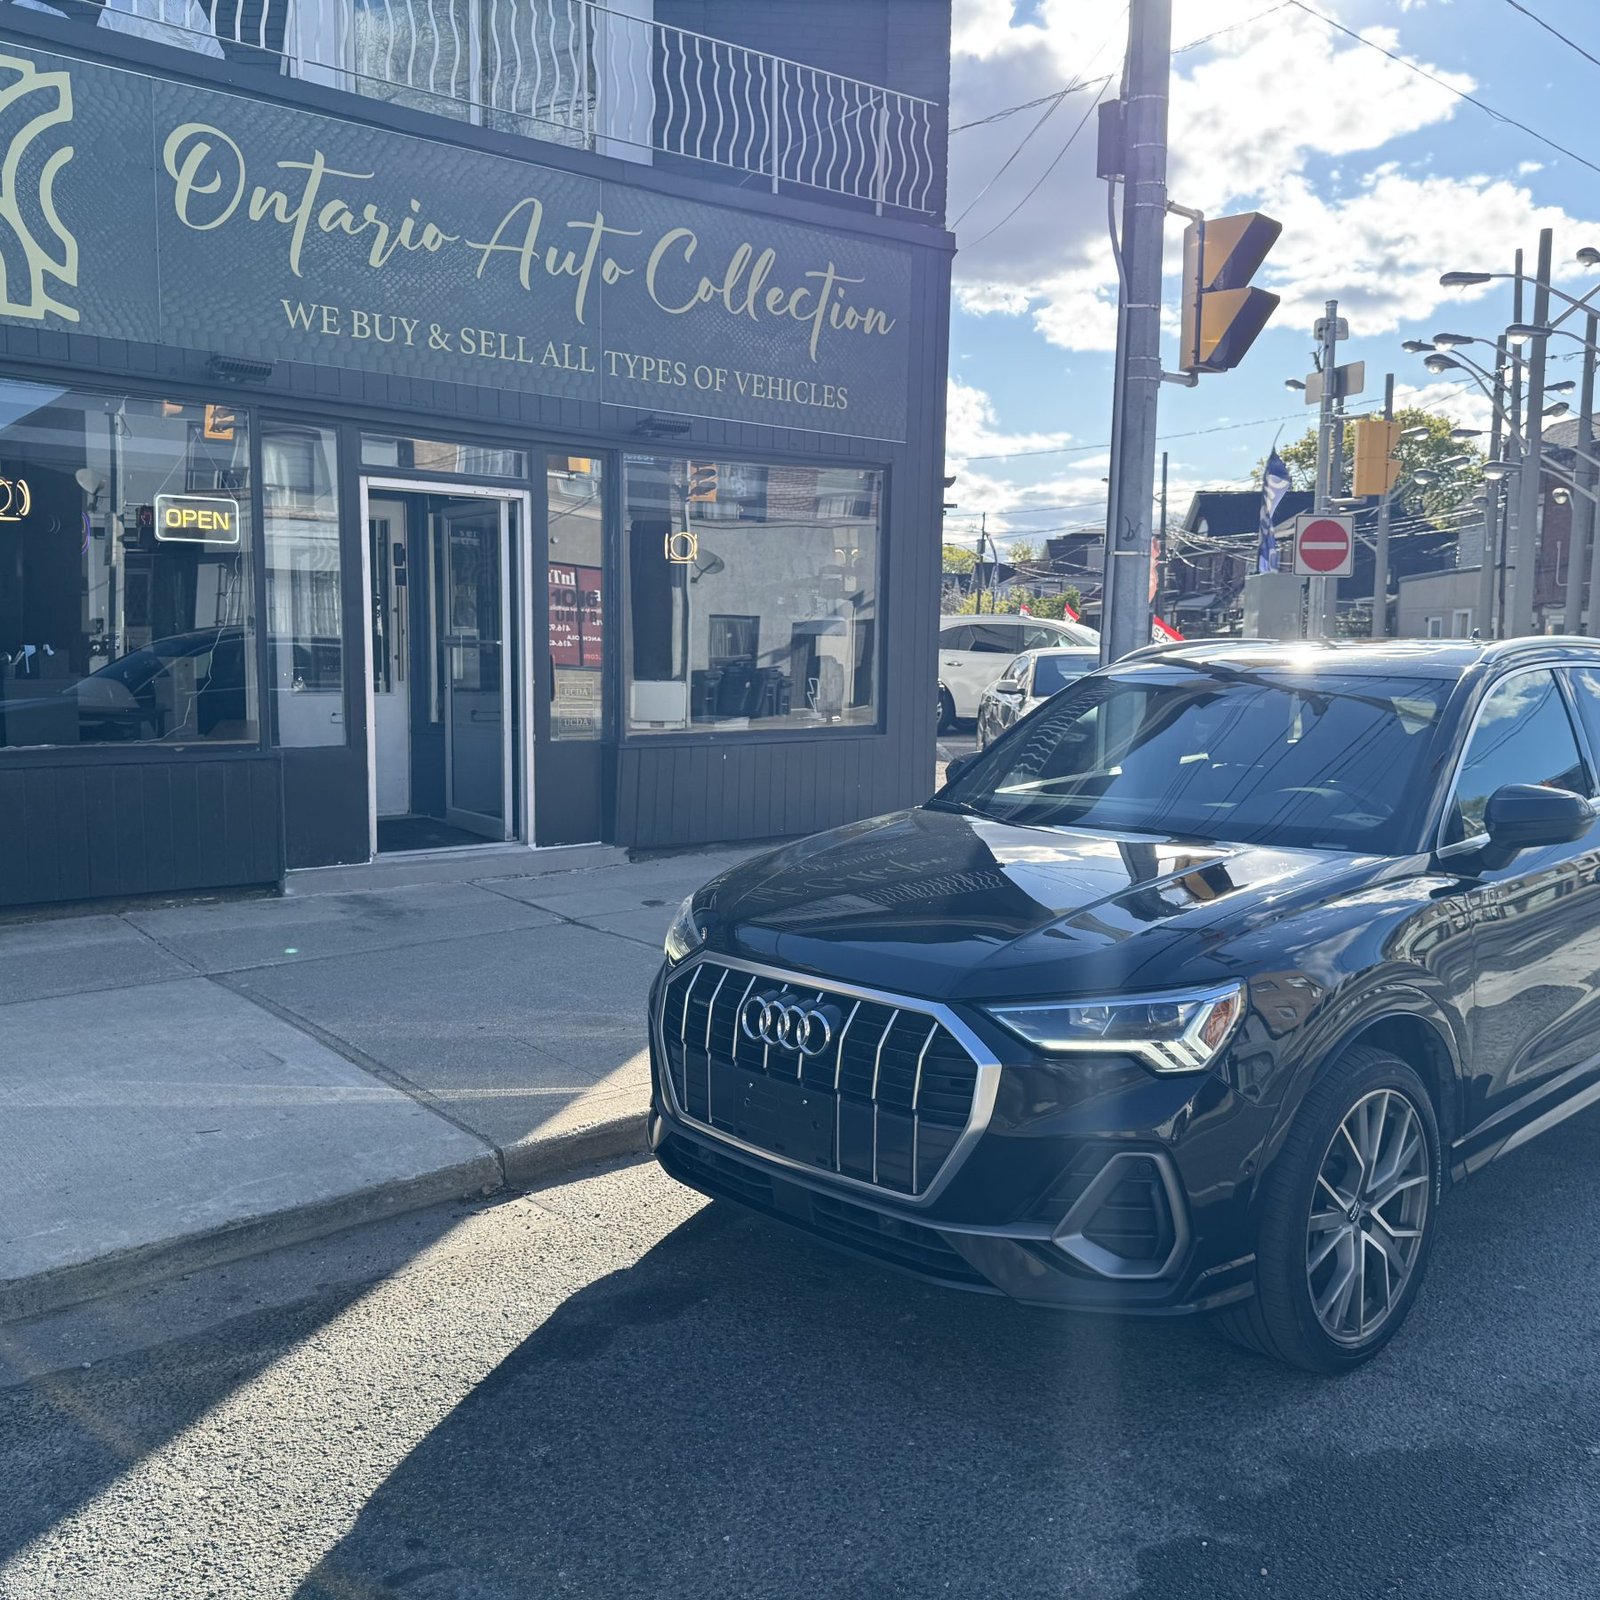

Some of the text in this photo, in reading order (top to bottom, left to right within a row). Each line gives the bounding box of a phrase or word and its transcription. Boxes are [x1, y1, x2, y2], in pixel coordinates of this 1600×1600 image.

[163, 122, 896, 363] Ontario Auto Collection
[280, 299, 849, 411] WE BUY & SELL ALL TYPES OF VEHICLES
[165, 508, 230, 531] OPEN
[564, 688, 588, 697] UCDA
[564, 718, 589, 727] UCDA
